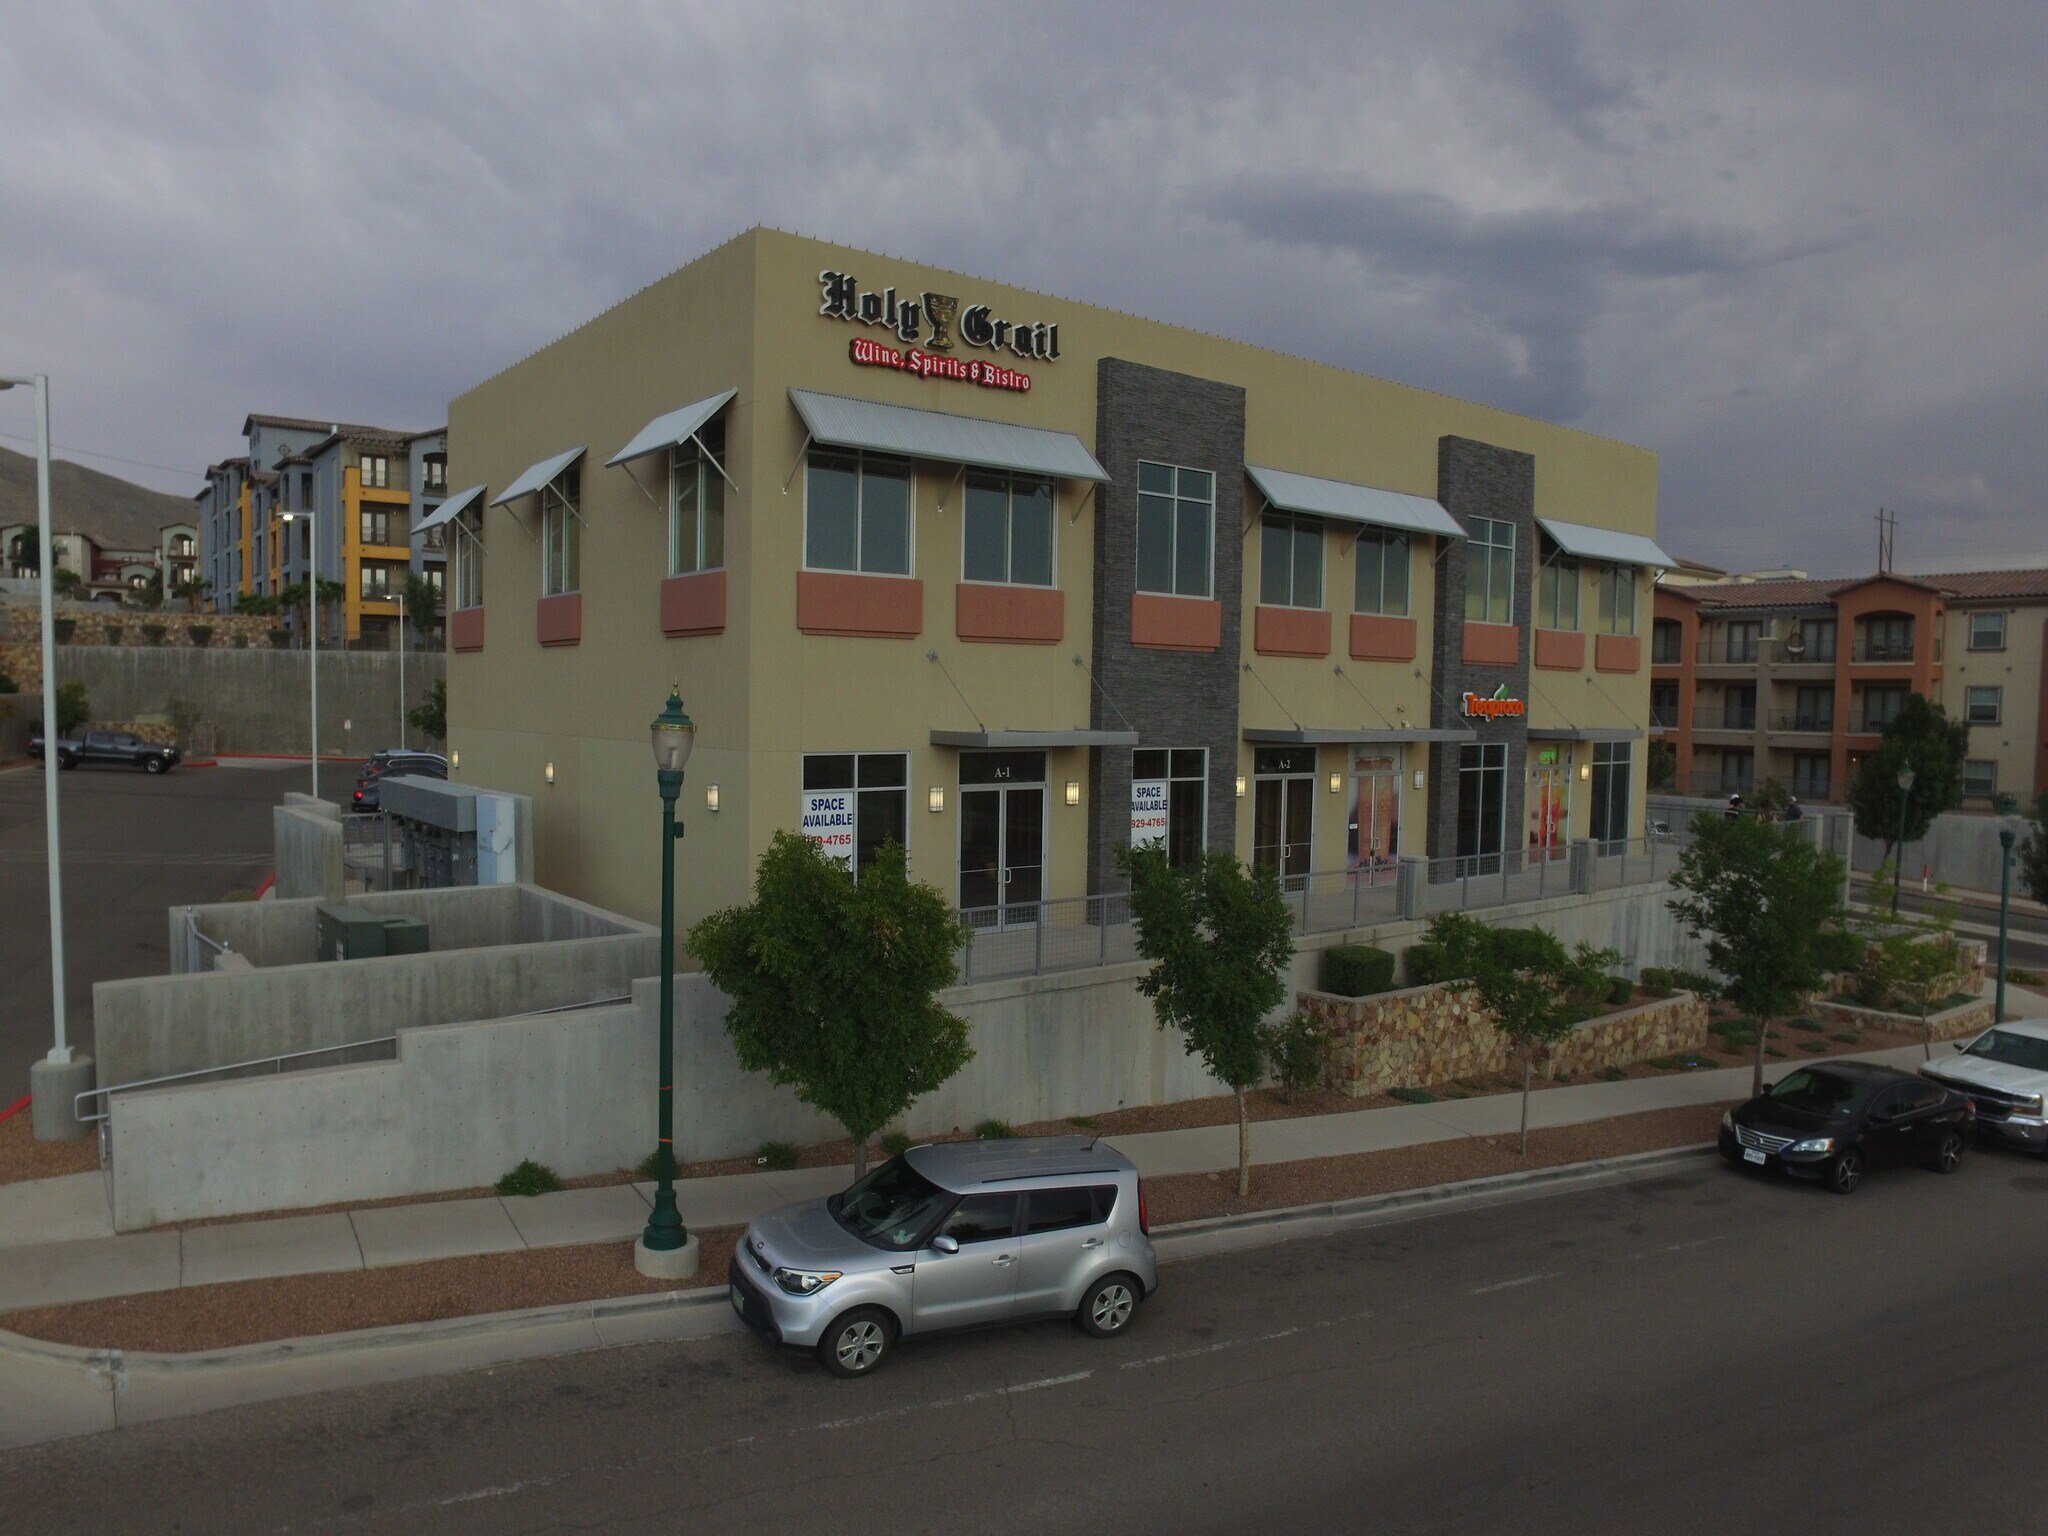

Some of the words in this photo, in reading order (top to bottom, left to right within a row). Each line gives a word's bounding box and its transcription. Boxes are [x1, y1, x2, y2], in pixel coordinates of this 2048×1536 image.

[819, 270, 921, 343] Holy
[960, 304, 1061, 362] Grail
[854, 340, 905, 367] Wine,
[910, 351, 967, 376] Spirits
[970, 362, 980, 379] &
[983, 364, 1030, 389] Bistro
[1463, 692, 1525, 721] Teapioca
[1279, 759, 1291, 769] A-2
[994, 766, 1011, 778] A-1
[1136, 786, 1161, 798] SPACE
[811, 798, 845, 811] SPACE
[1131, 799, 1167, 812] AVAILABLE
[802, 813, 853, 828] AVAILABLE
[1131, 817, 1165, 828] 929-4765
